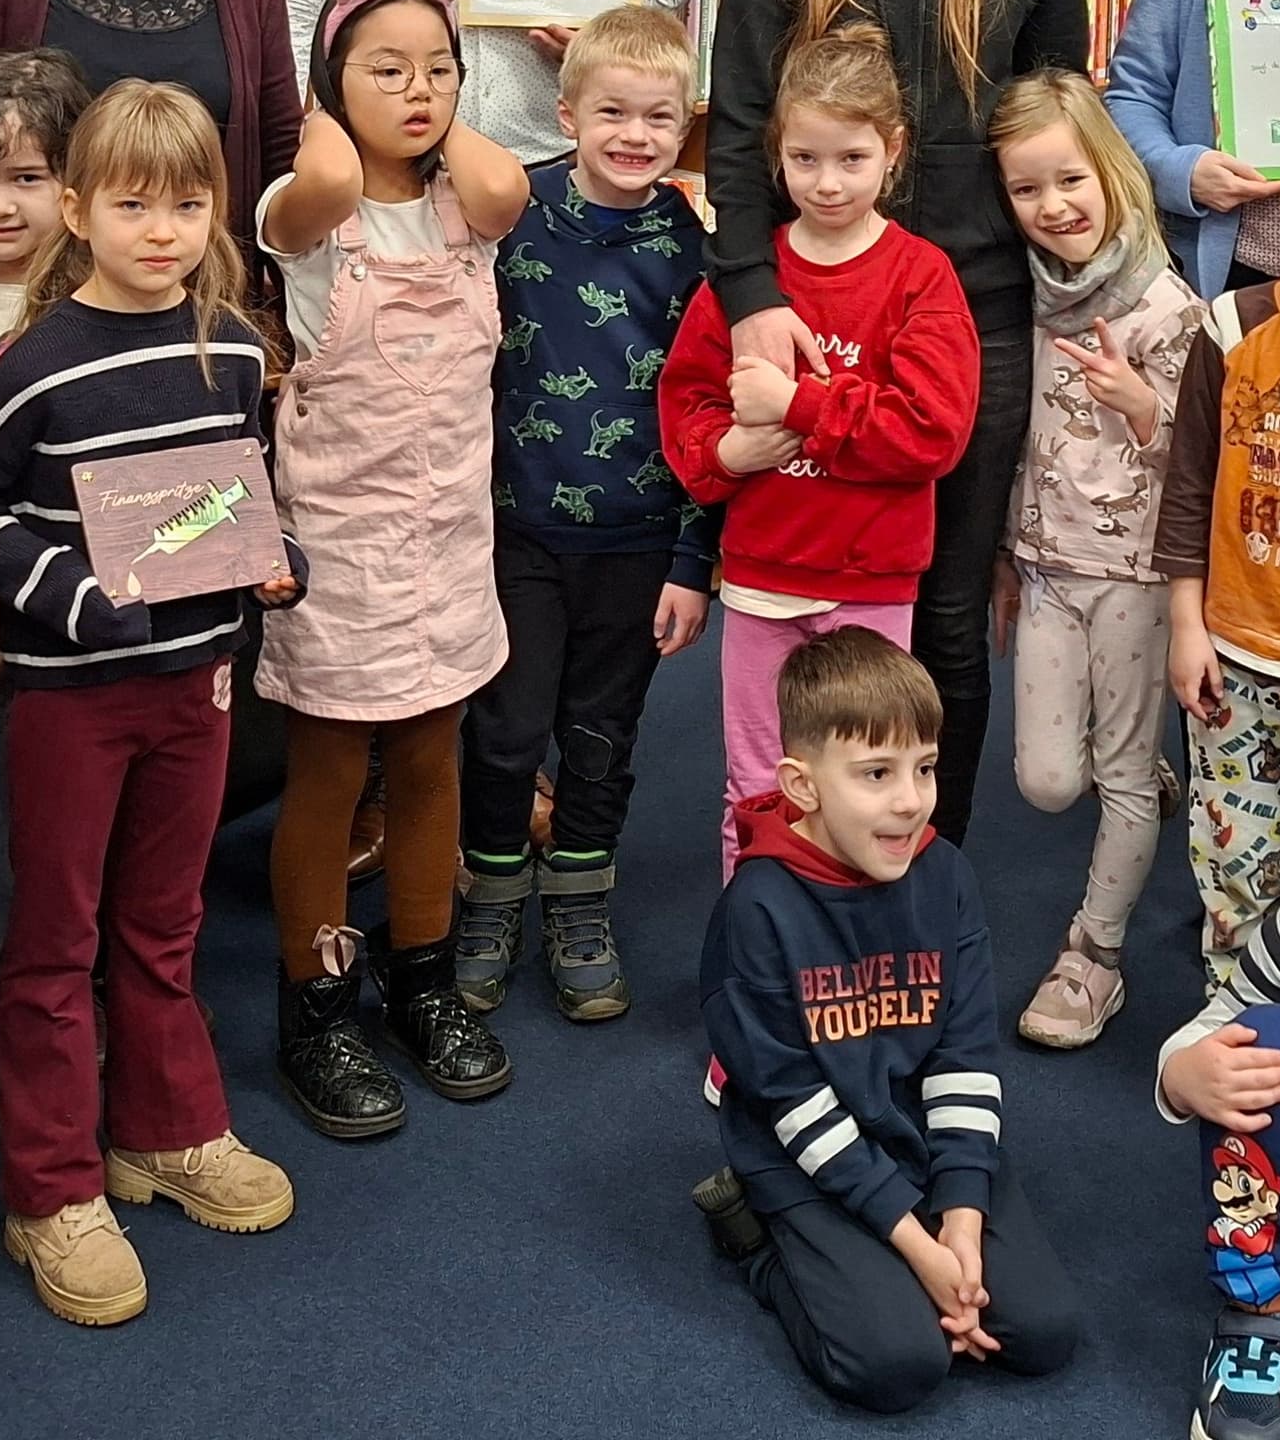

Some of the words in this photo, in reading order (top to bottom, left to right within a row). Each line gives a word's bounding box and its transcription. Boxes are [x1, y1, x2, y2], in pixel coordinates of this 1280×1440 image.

[816, 333, 863, 367] rry
[98, 480, 206, 513] Finanzspritze
[906, 950, 943, 985] IN
